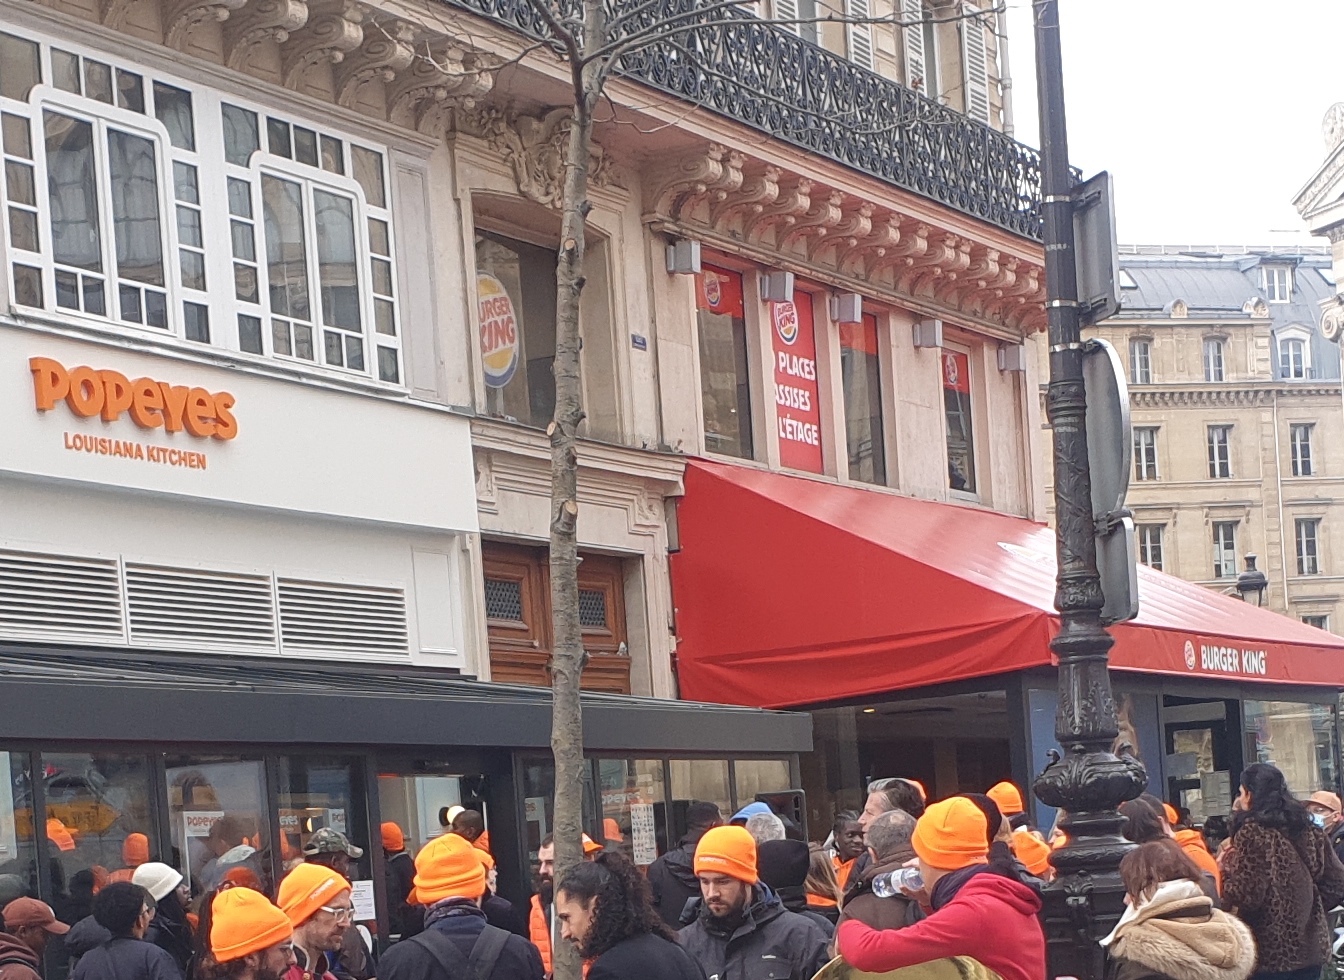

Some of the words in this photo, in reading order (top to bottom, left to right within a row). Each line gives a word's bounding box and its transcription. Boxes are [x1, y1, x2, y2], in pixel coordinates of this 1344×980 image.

[480, 297, 509, 322] URGER
[778, 351, 816, 381] PLACES
[779, 414, 819, 446] L'ÉTAGE
[64, 432, 144, 460] LOUISIANA
[146, 445, 207, 470] KITCHEN
[1201, 644, 1240, 673] BURGER
[1242, 649, 1267, 676] KING
